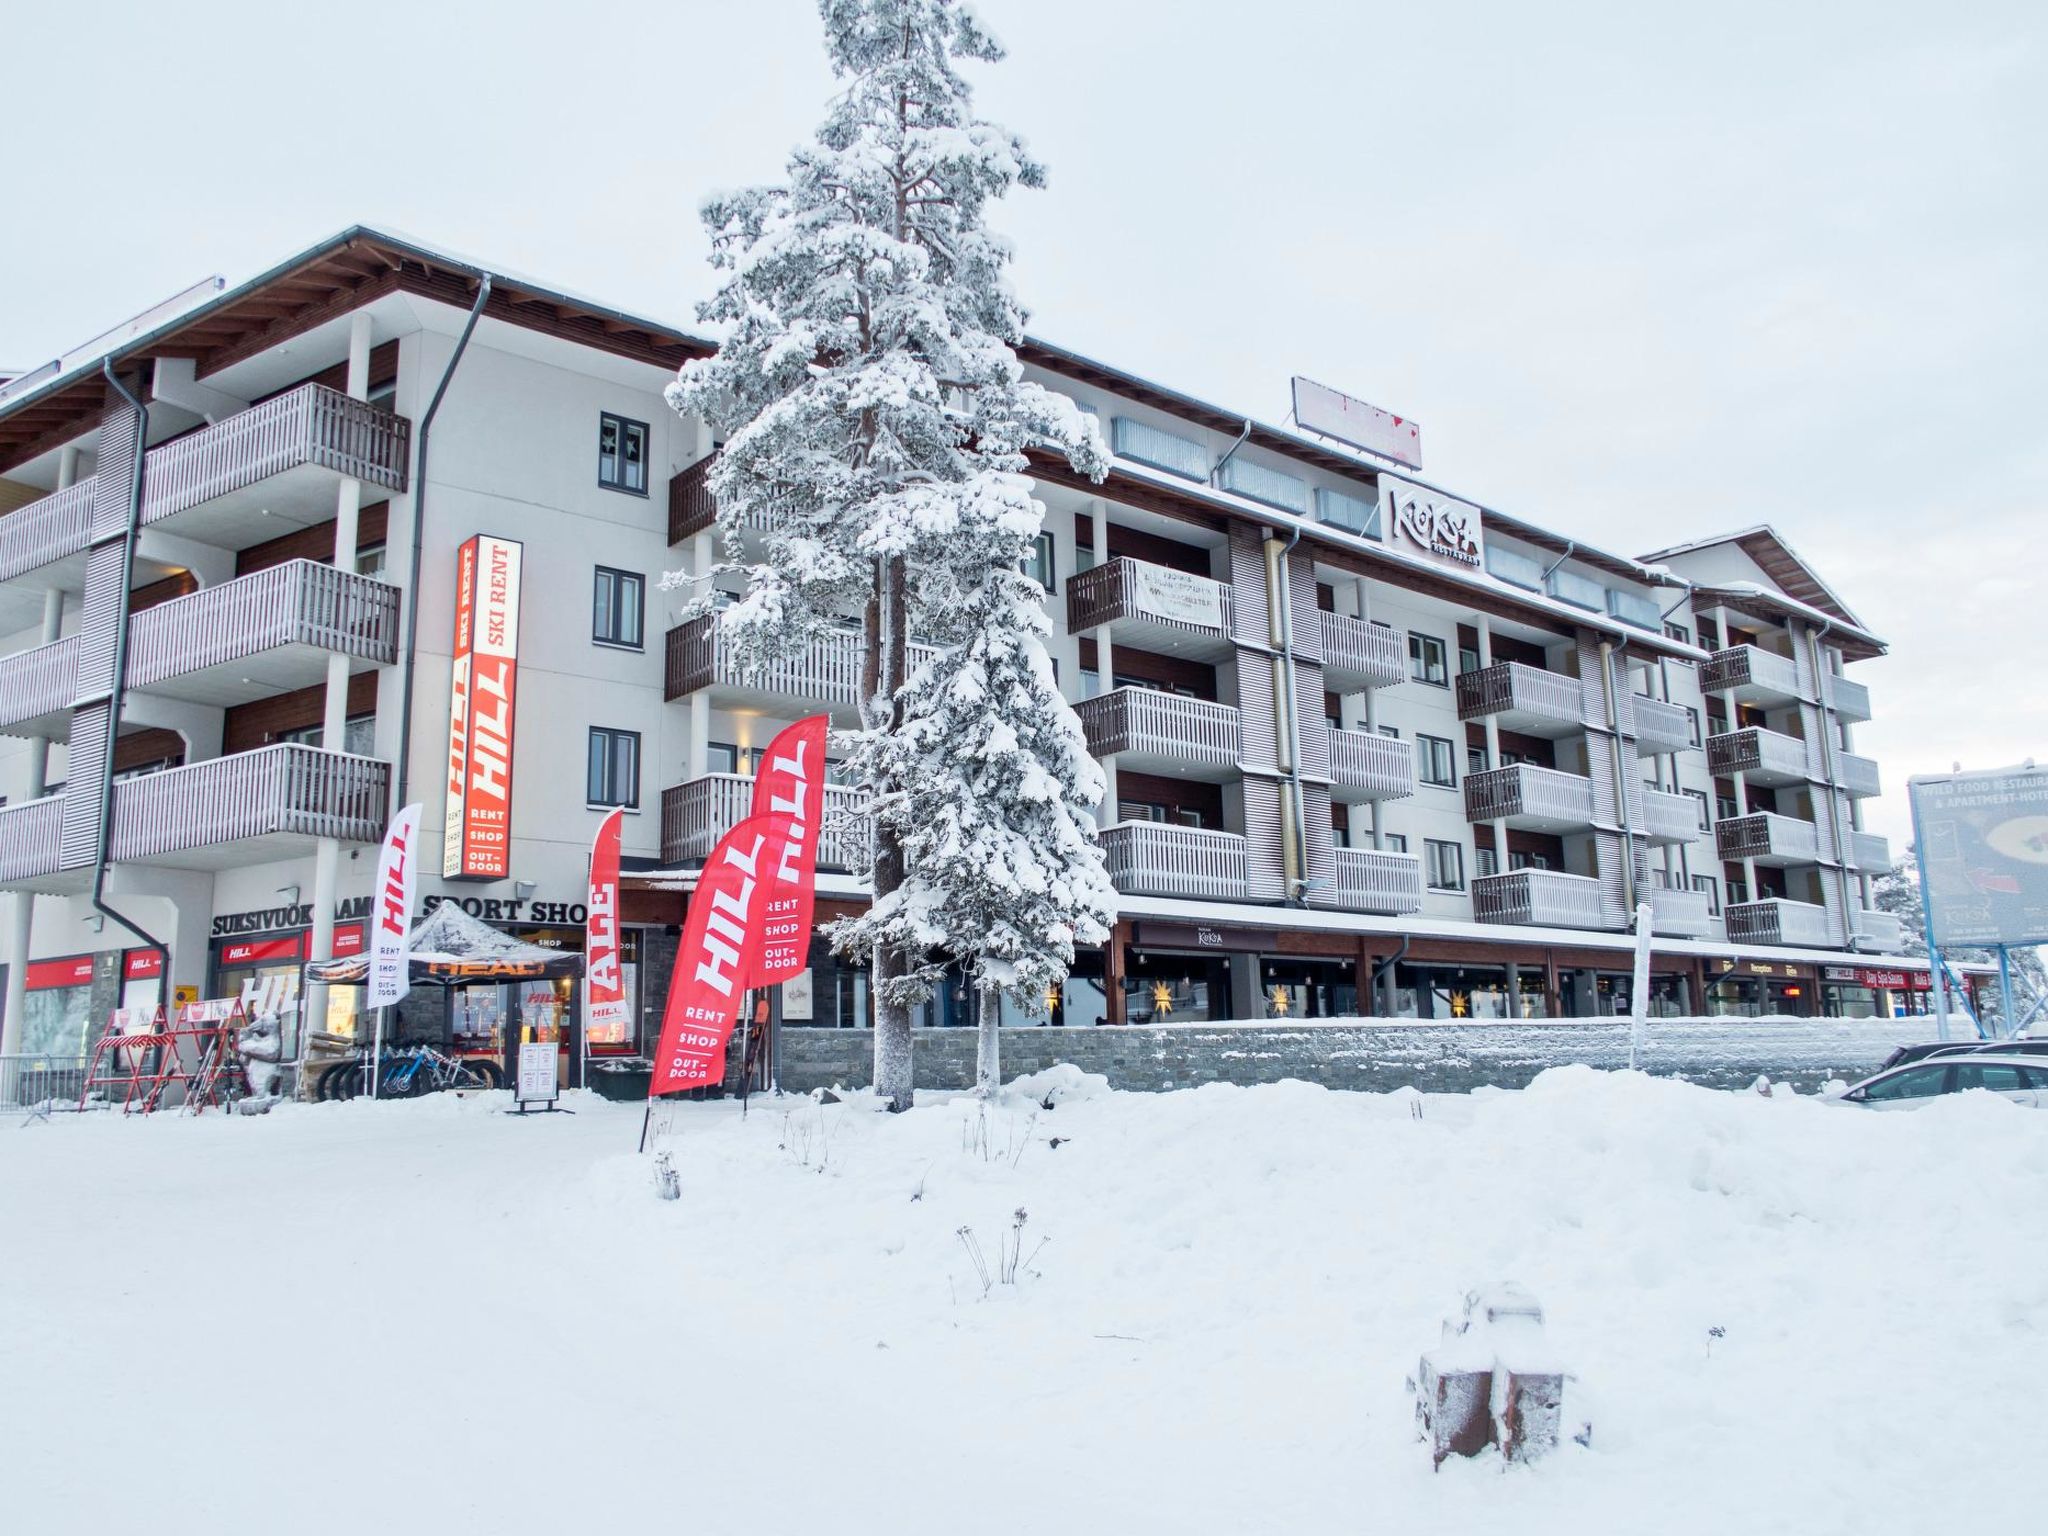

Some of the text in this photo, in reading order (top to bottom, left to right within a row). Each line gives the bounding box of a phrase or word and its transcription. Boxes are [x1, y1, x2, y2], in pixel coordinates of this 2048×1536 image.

[460, 547, 472, 648] SKI RENT
[488, 545, 508, 646] SKI RENT
[450, 662, 466, 796] HILL
[472, 662, 508, 801] HILL
[1921, 785, 1954, 796] WILD
[1958, 782, 1989, 793] FOOD
[471, 808, 504, 820] RENT
[470, 830, 504, 842] SHOP
[469, 852, 501, 861] OUT-
[468, 862, 502, 872] DOOR
[382, 823, 410, 937] HILL
[767, 899, 798, 912] RENT
[212, 896, 375, 935] SUKSIVUOKAM
[694, 833, 766, 998] HILL
[765, 923, 799, 936] SHOP
[538, 939, 562, 947] SHOP
[590, 883, 617, 993] ALE
[229, 947, 251, 959] HILL
[380, 947, 400, 955] RENT
[765, 947, 795, 958] OUT-
[131, 959, 151, 970] HILL
[427, 959, 545, 976] HEAD
[765, 957, 797, 969] DOOR
[1888, 972, 1904, 985] Sauna
[591, 1007, 621, 1018] HILL
[685, 1007, 726, 1023] RENT
[679, 1033, 719, 1047] SHOP
[673, 1058, 708, 1069] OUT-
[669, 1069, 707, 1078] DOOR
